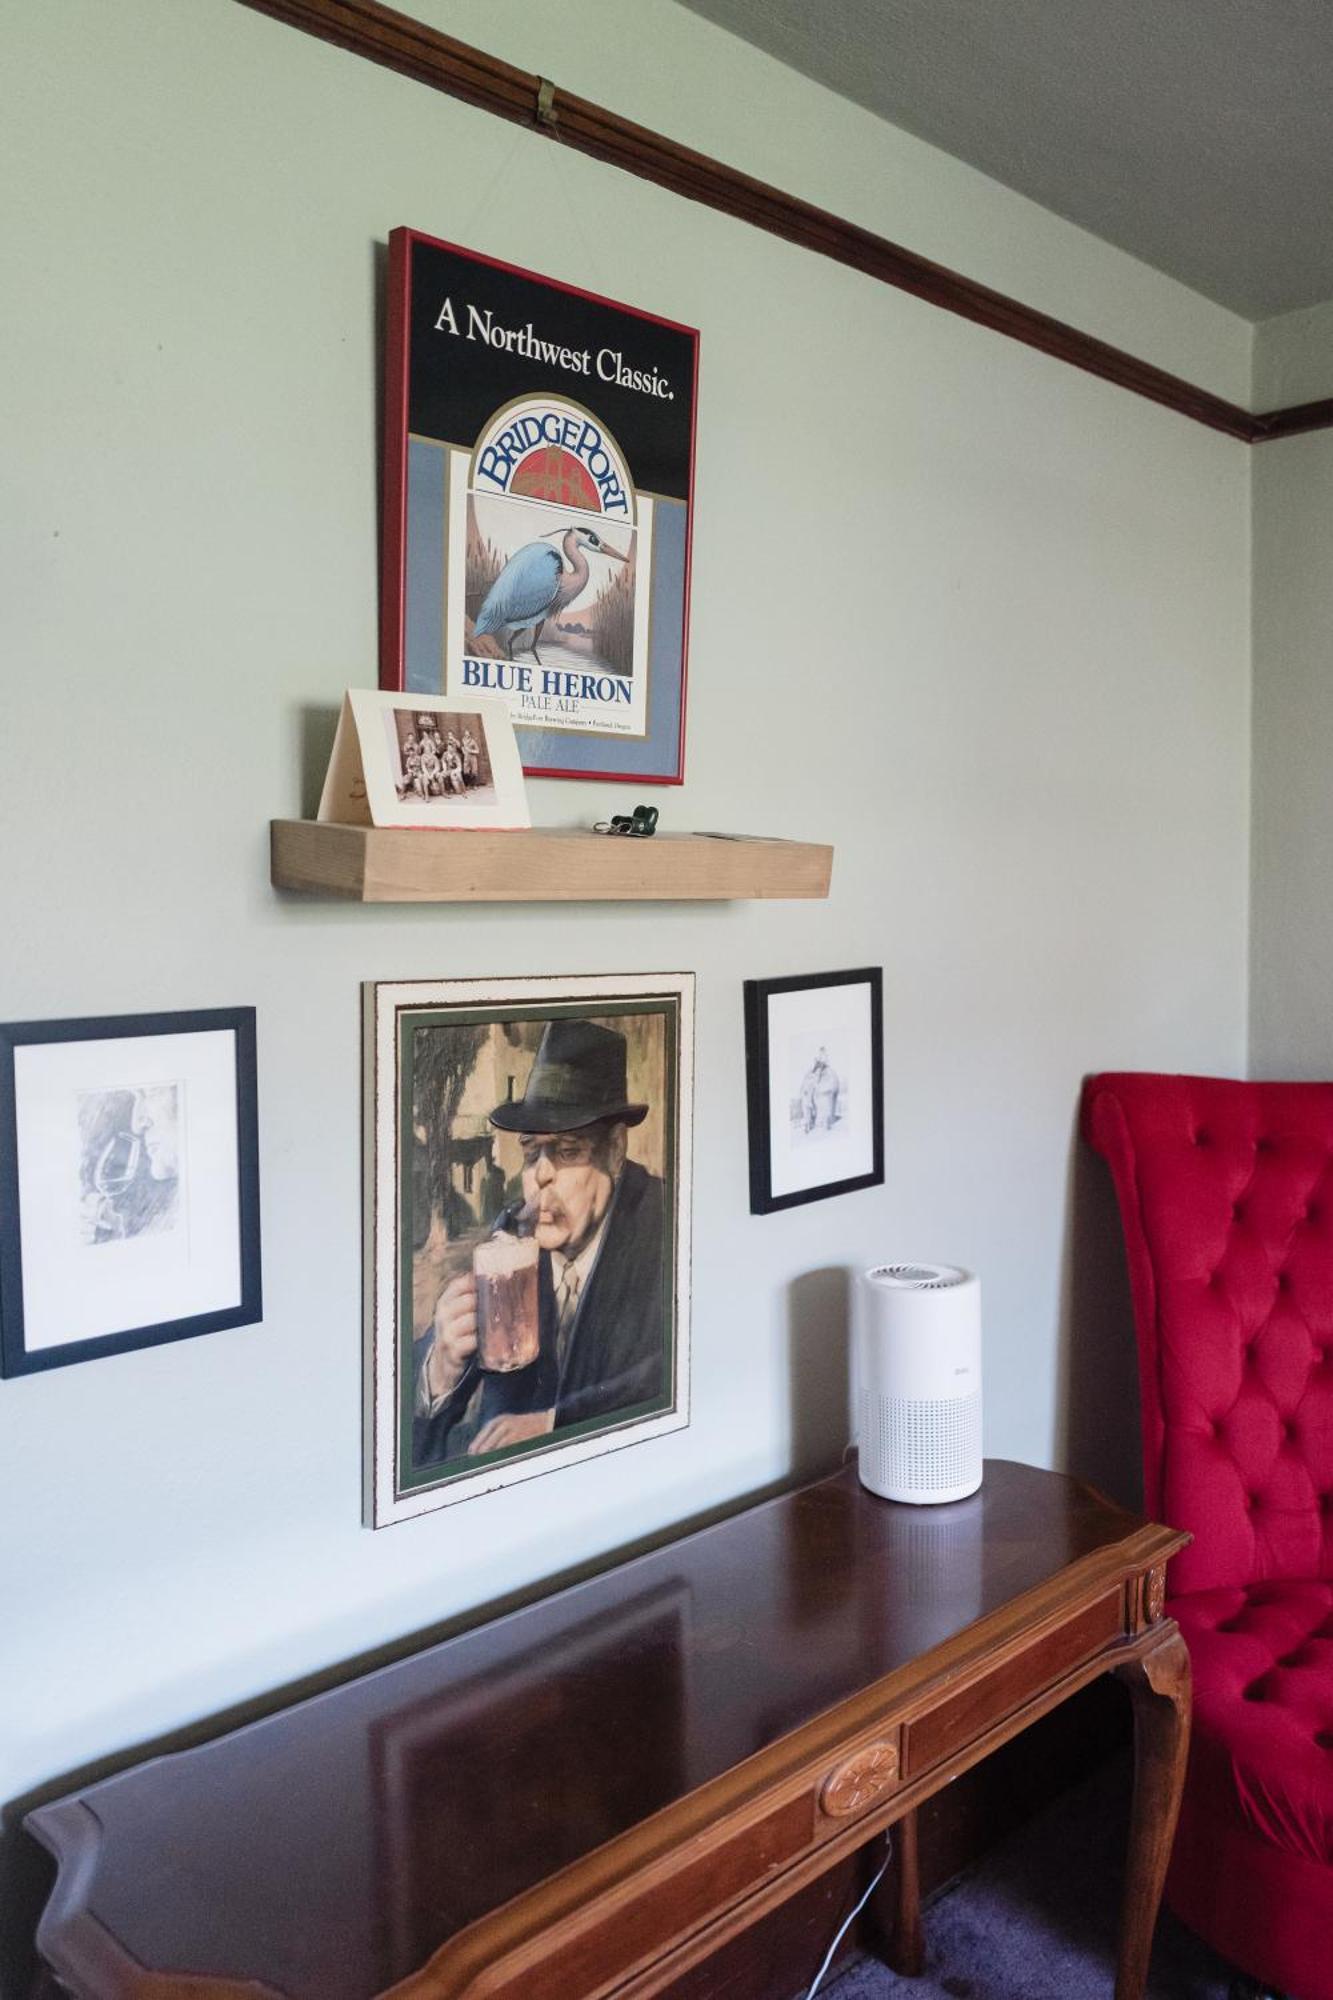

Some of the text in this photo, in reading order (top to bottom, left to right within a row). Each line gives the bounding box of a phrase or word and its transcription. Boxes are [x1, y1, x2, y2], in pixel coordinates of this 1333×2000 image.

[434, 297, 675, 400] A Northwest Classic.
[462, 659, 634, 705] BLUE HERON
[521, 694, 579, 713] PALE ALE
